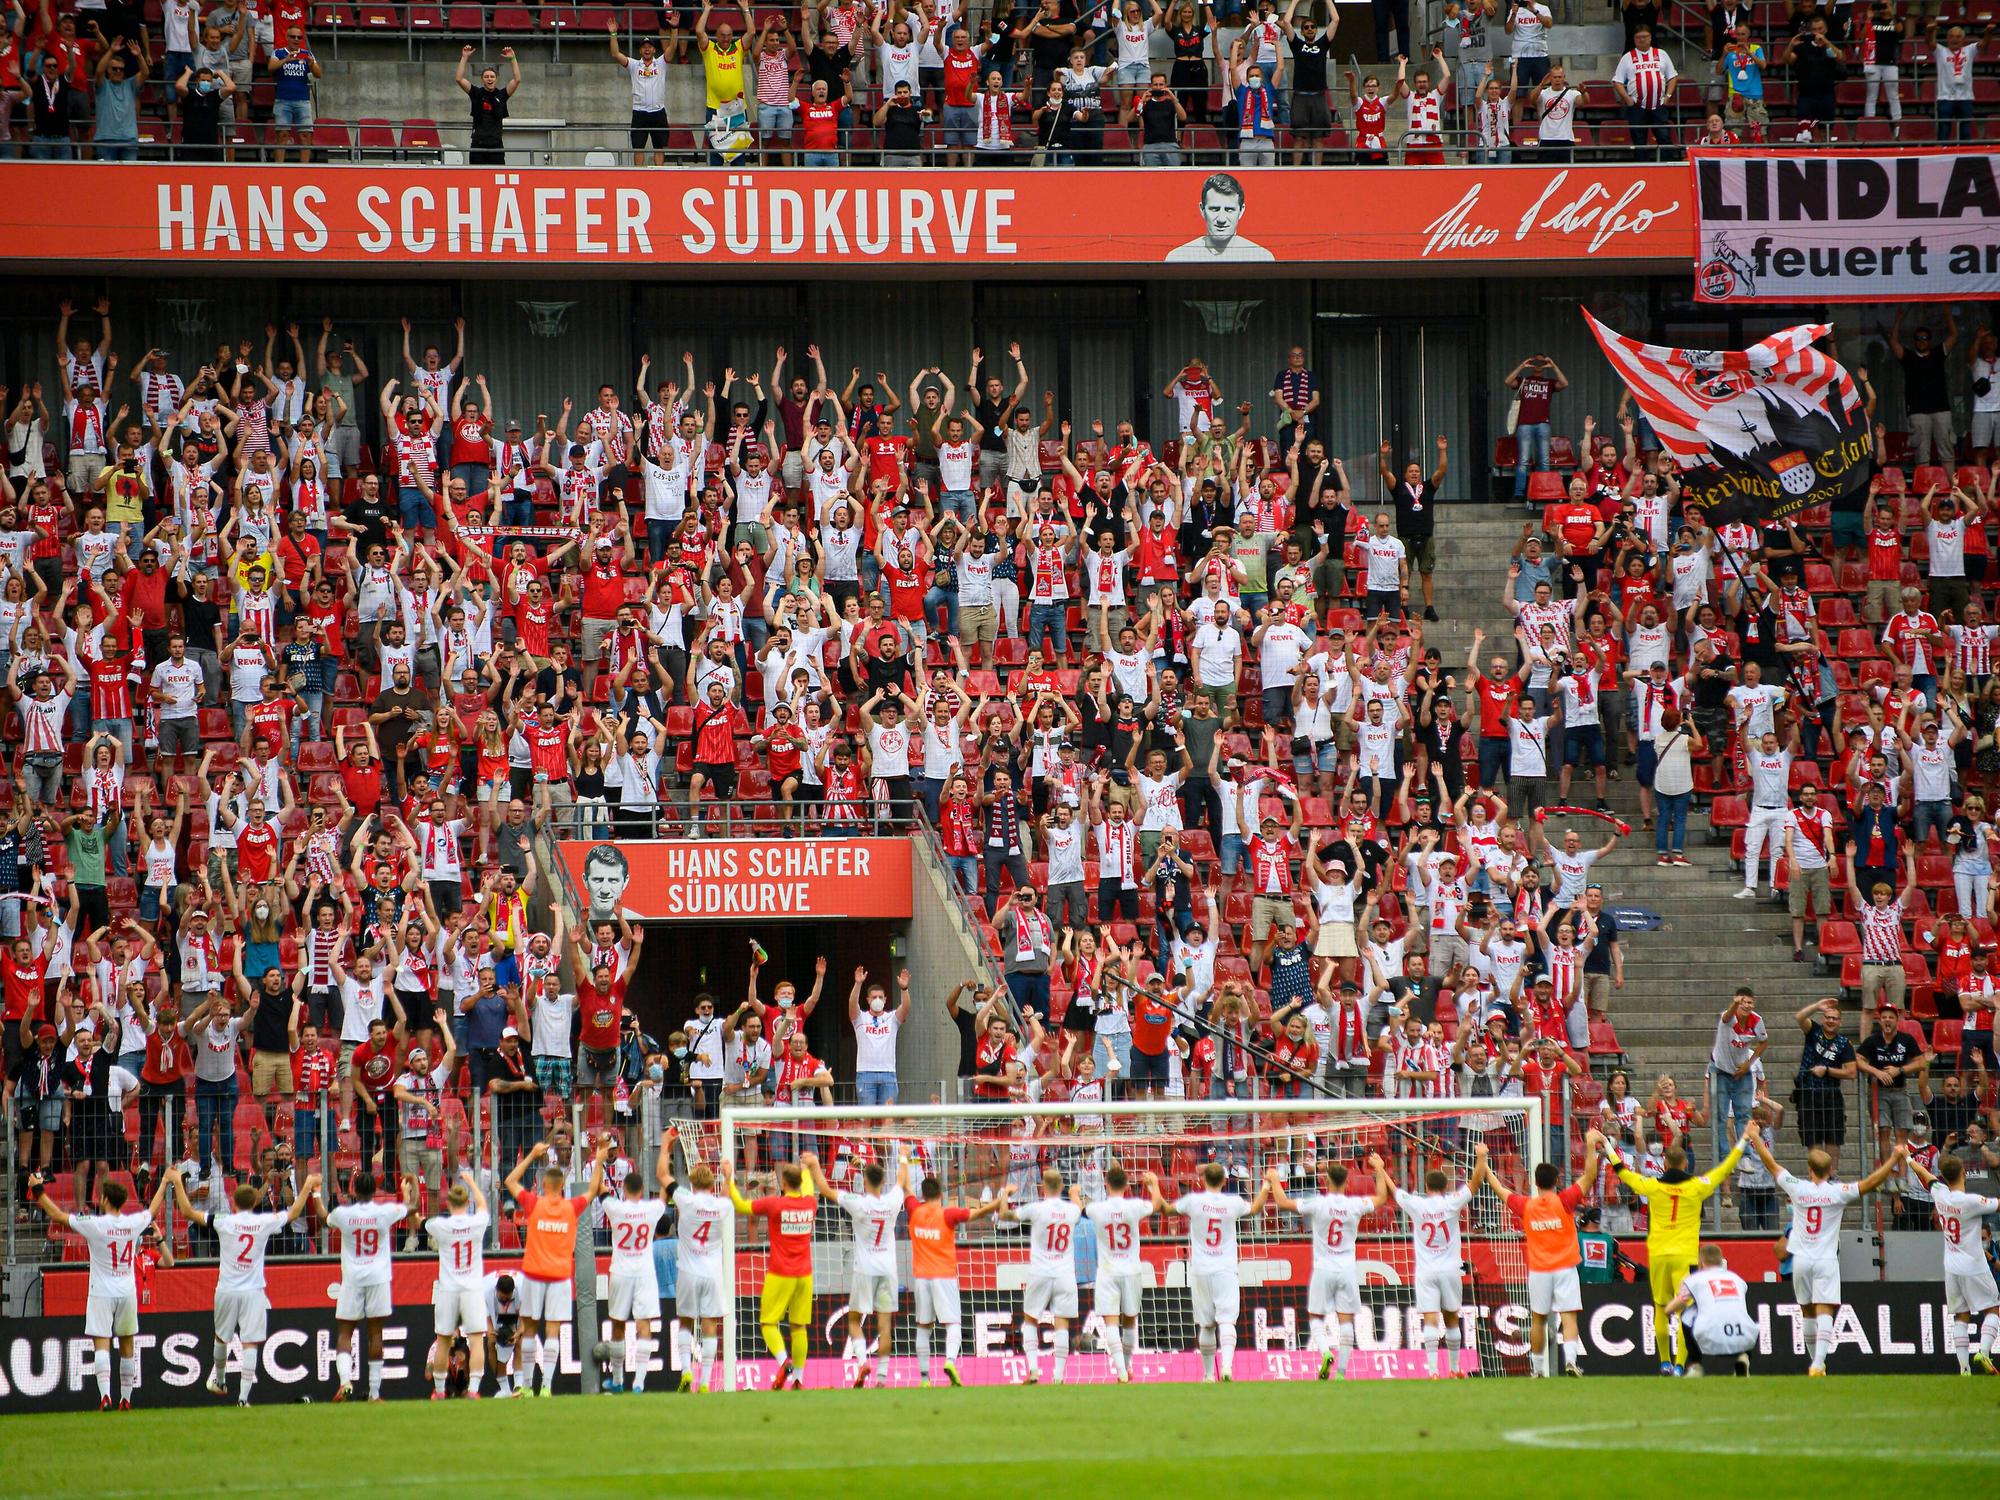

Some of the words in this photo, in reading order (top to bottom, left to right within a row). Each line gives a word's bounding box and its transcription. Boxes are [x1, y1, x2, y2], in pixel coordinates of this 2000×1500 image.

[1125, 34, 1145, 43] REWE
[951, 60, 973, 68] REWE
[1636, 62, 1659, 70] REWE
[810, 110, 833, 119] REWE
[157, 183, 329, 253] HANS
[356, 174, 655, 254] SCHÄFER
[681, 175, 1018, 255] SÜDKURVE
[1750, 236, 1939, 277] feuert
[411, 444, 424, 452] EW
[947, 452, 968, 460] REWE
[1771, 499, 1804, 519] since
[1807, 482, 1844, 506] 2007
[1567, 515, 1592, 523] REWE
[1936, 531, 1959, 539] REWE
[0, 541, 16, 549] EWE
[1874, 537, 1897, 546] REWE
[1237, 547, 1260, 555] REWE
[1372, 549, 1396, 557] REWE
[240, 569, 251, 577] RE
[967, 566, 989, 574] REWE
[896, 579, 920, 587] REWE
[1627, 586, 1650, 594] REWE
[526, 612, 546, 623] REWE
[1203, 615, 1217, 623] RE
[1536, 614, 1559, 622] REWE
[1640, 634, 1663, 642] REWE
[1963, 637, 1987, 646] REWE
[290, 653, 315, 661] REWE
[388, 657, 410, 665] REWE
[237, 658, 262, 666] REWE
[98, 674, 122, 682] REWE
[168, 675, 189, 683] REWE
[708, 672, 729, 685] REWE
[1027, 682, 1051, 691] REWE
[1743, 696, 1768, 706] REWE
[255, 714, 278, 722] REWE
[538, 737, 560, 745] REWE
[1368, 732, 1388, 741] REWE
[771, 744, 793, 752] REWE
[1761, 761, 1783, 769] REWE
[247, 834, 270, 842] REWE
[310, 846, 322, 854] RE
[667, 853, 739, 880] HANS
[748, 846, 870, 879] SCHÄFER
[1261, 854, 1284, 863] REWE
[1562, 864, 1585, 873] REWE
[667, 883, 811, 914] SÜDKURVE
[1946, 948, 1970, 957] REWE
[1280, 955, 1303, 966] REWE
[1496, 955, 1520, 964] REWE
[15, 970, 38, 980] REWE
[865, 1026, 889, 1034] REWE
[208, 1042, 230, 1052] REWE
[1204, 1052, 1217, 1063] RE
[1077, 1092, 1098, 1100] REWE
[1669, 1195, 1680, 1223] 1
[780, 1210, 814, 1223] REWE
[1805, 1206, 1823, 1235] 9
[537, 1219, 568, 1234] REWE
[1530, 1217, 1563, 1231] REWE
[617, 1222, 650, 1251] 28
[692, 1220, 712, 1246] 4
[871, 1218, 886, 1247] 7
[1104, 1223, 1132, 1251] 13
[1205, 1218, 1222, 1249] 5
[1327, 1218, 1344, 1248] 6
[1420, 1219, 1450, 1249] 21
[1046, 1223, 1071, 1253] 18
[352, 1228, 380, 1258] 19
[236, 1233, 254, 1264] 2
[107, 1239, 133, 1271] 14
[451, 1239, 473, 1270] 11
[1723, 1323, 1743, 1337] 01
